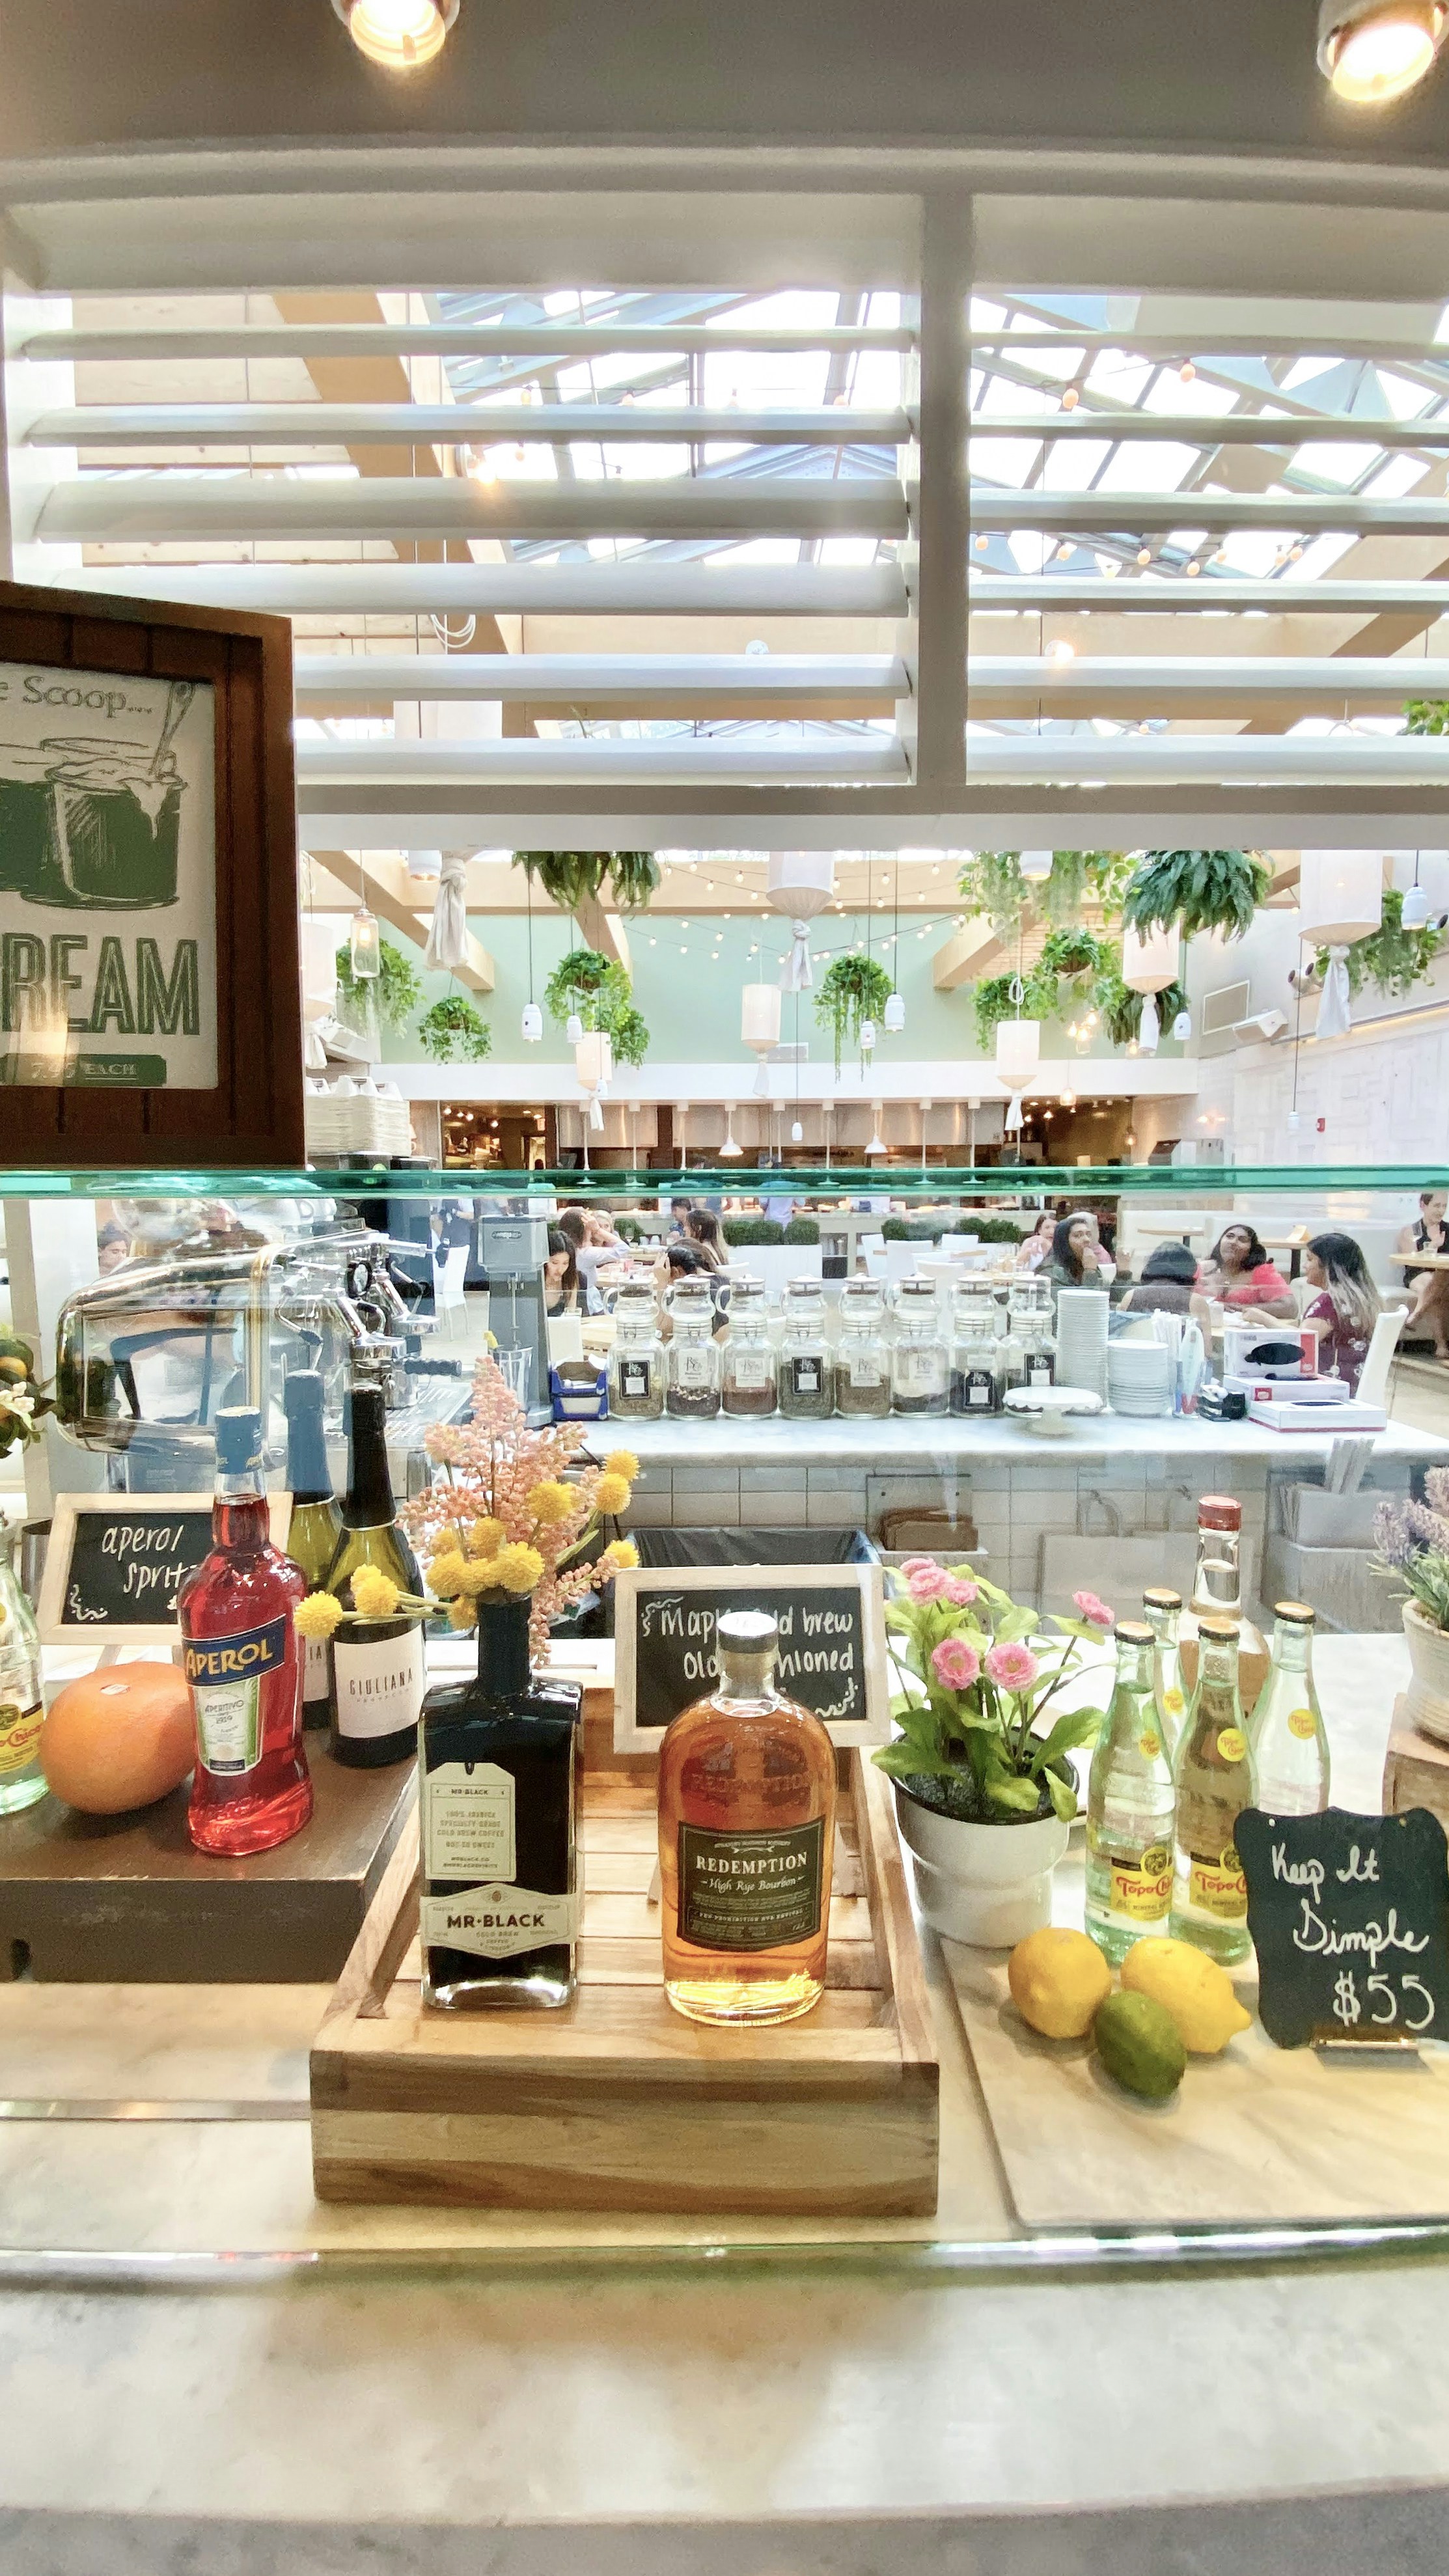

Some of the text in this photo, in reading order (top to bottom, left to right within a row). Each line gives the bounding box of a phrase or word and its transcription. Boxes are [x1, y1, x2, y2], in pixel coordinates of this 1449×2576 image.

[102, 1524, 184, 1562] aperol
[803, 1607, 854, 1635] brew
[186, 1639, 273, 1678] APEROL
[350, 1667, 413, 1696] GIULIANA
[695, 1851, 808, 1875] REDEMPTION
[1271, 1842, 1380, 1904] Keep It
[758, 1875, 797, 1890] Bourbon
[1116, 1876, 1154, 1897] Topo
[1293, 1898, 1430, 1969] Simple
[1333, 1969, 1435, 2030] $55
